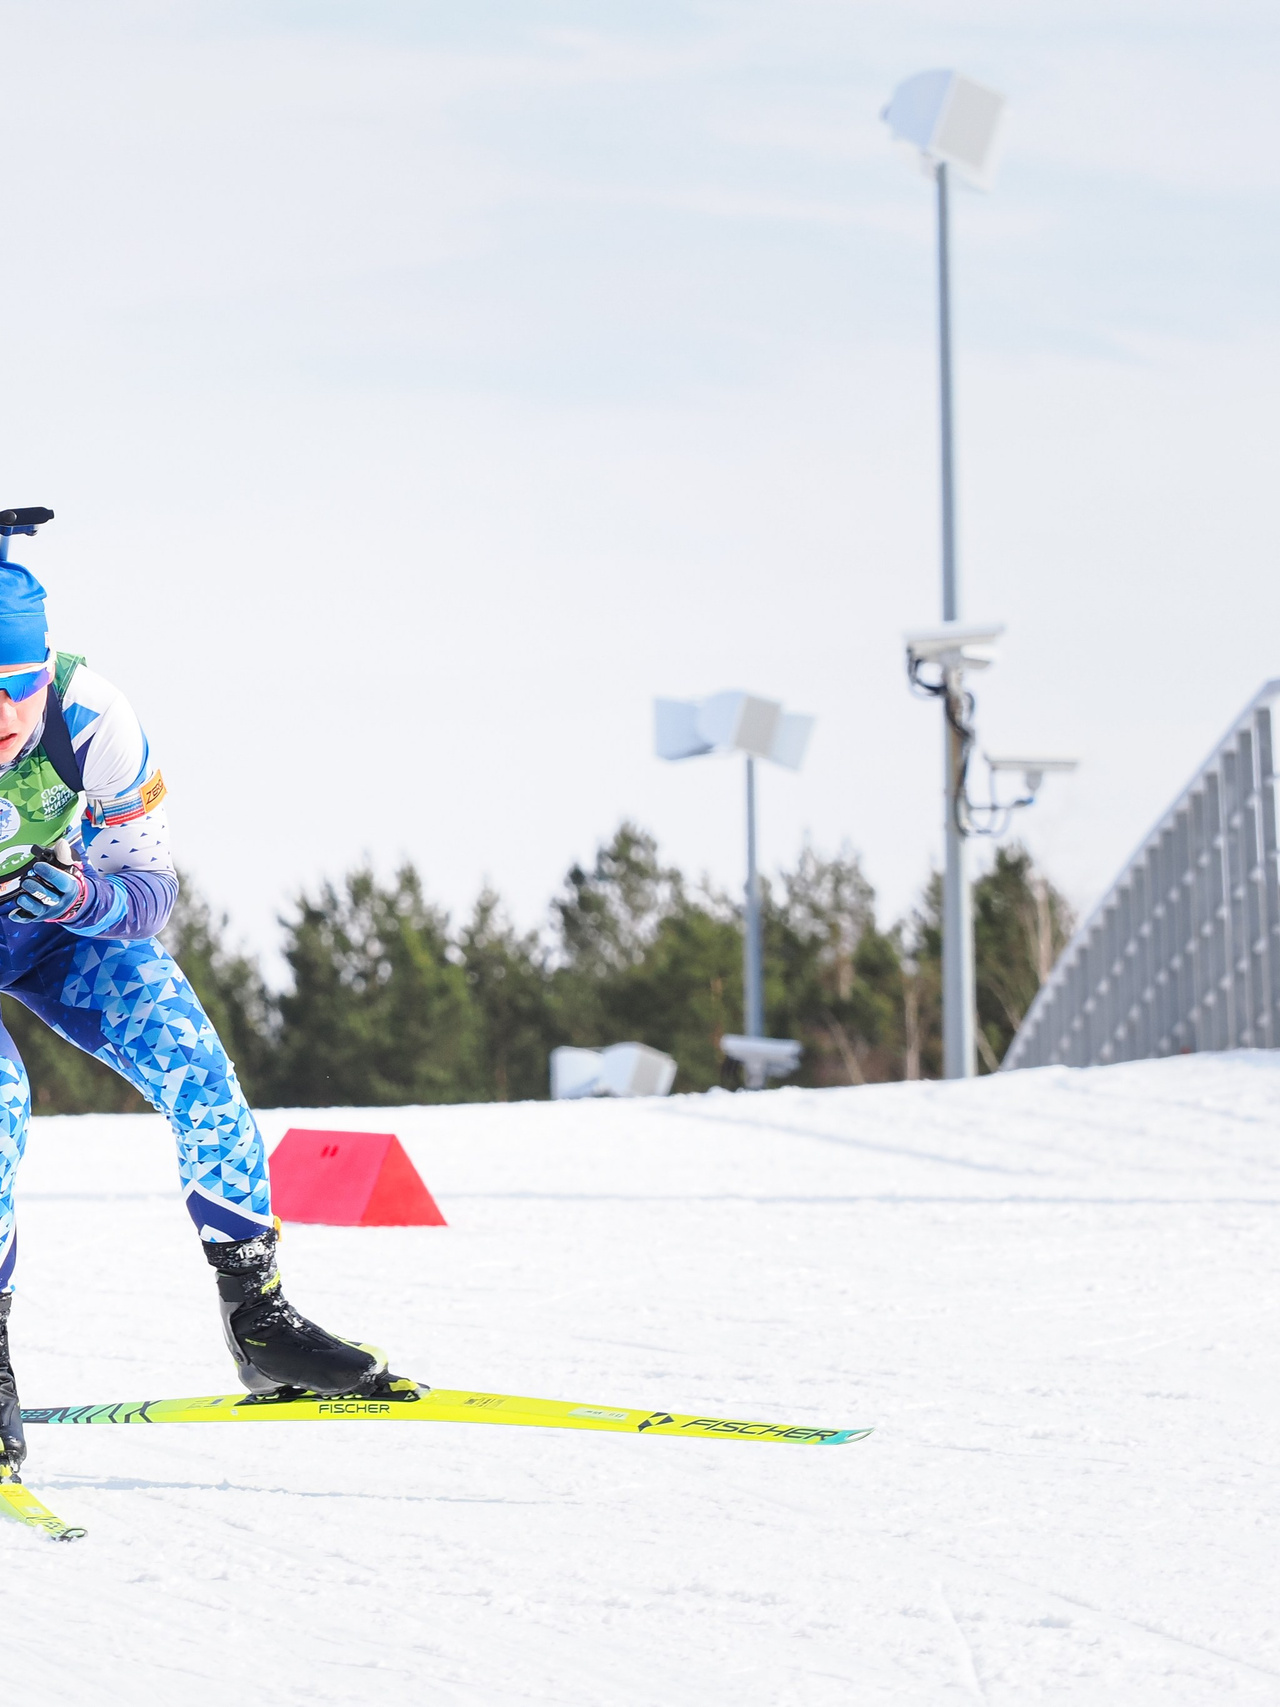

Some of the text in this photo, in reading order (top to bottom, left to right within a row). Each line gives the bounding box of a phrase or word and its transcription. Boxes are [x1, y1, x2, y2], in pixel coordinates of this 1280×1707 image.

[40, 783, 68, 799] СПОР
[318, 1403, 391, 1414] FISCHER
[680, 1418, 841, 1442] FISCHER
